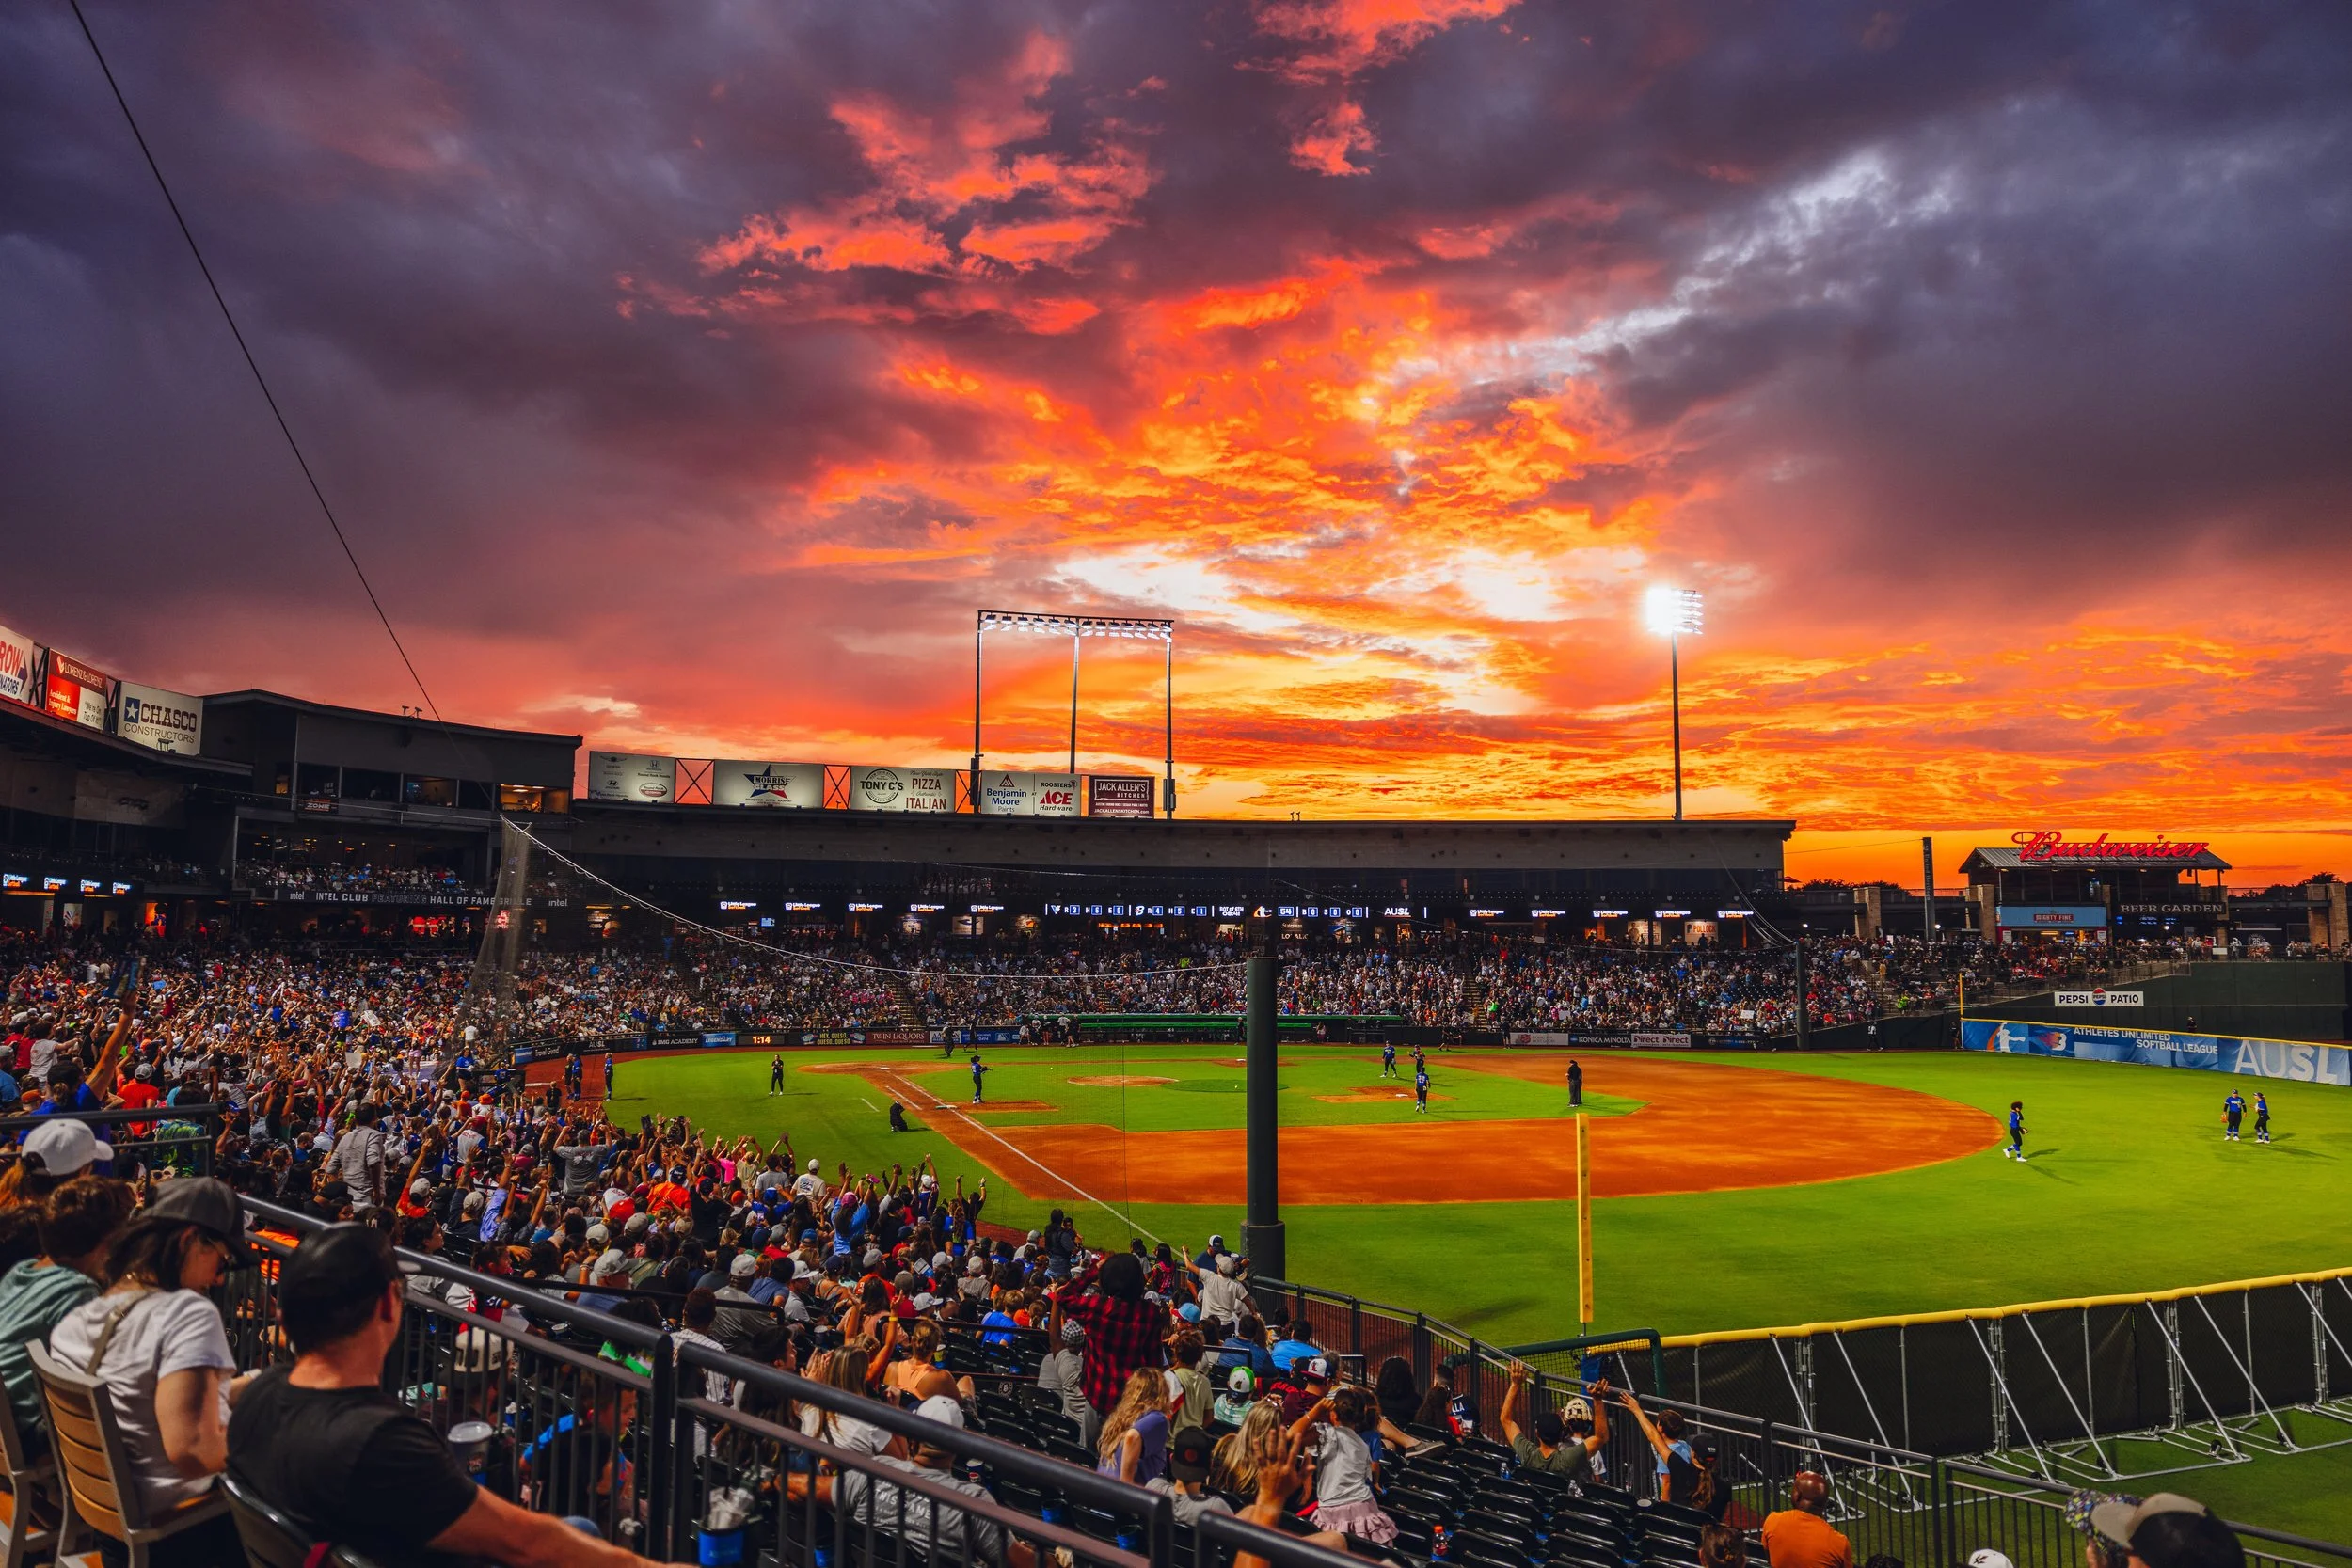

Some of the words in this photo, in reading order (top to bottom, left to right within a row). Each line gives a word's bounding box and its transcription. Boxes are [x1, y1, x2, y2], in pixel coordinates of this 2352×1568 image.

[141, 704, 197, 732] CHASCO
[124, 722, 195, 743] CONSTRUCTORS
[860, 781, 887, 789] TONY
[889, 782, 904, 790] C'S
[912, 779, 941, 790] PIZZA
[1098, 782, 1116, 791] JACK
[1117, 783, 1146, 792] ALLEN'S
[987, 788, 1027, 798] Benjamin
[1040, 790, 1073, 804] ACE
[906, 797, 946, 809] ITALIAN
[2011, 832, 2209, 862] Budweiser
[316, 892, 338, 901] INTEL
[342, 893, 368, 902] CLUB
[372, 894, 427, 903] FEATURING
[1384, 907, 1410, 916] AUSL
[2161, 904, 2222, 913] GARDEN
[1693, 925, 1715, 933] POLLOCK
[2059, 995, 2088, 1003] PEPSI
[2111, 995, 2139, 1003] PATIO
[2074, 1027, 2119, 1037] ATHLETES
[2122, 1031, 2171, 1041] UNLIMITED
[2137, 1040, 2181, 1051] SOFTBALL
[2183, 1044, 2218, 1054] LEAGUE
[2234, 1039, 2337, 1084] AUSL
[875, 1489, 898, 1505] THIS
